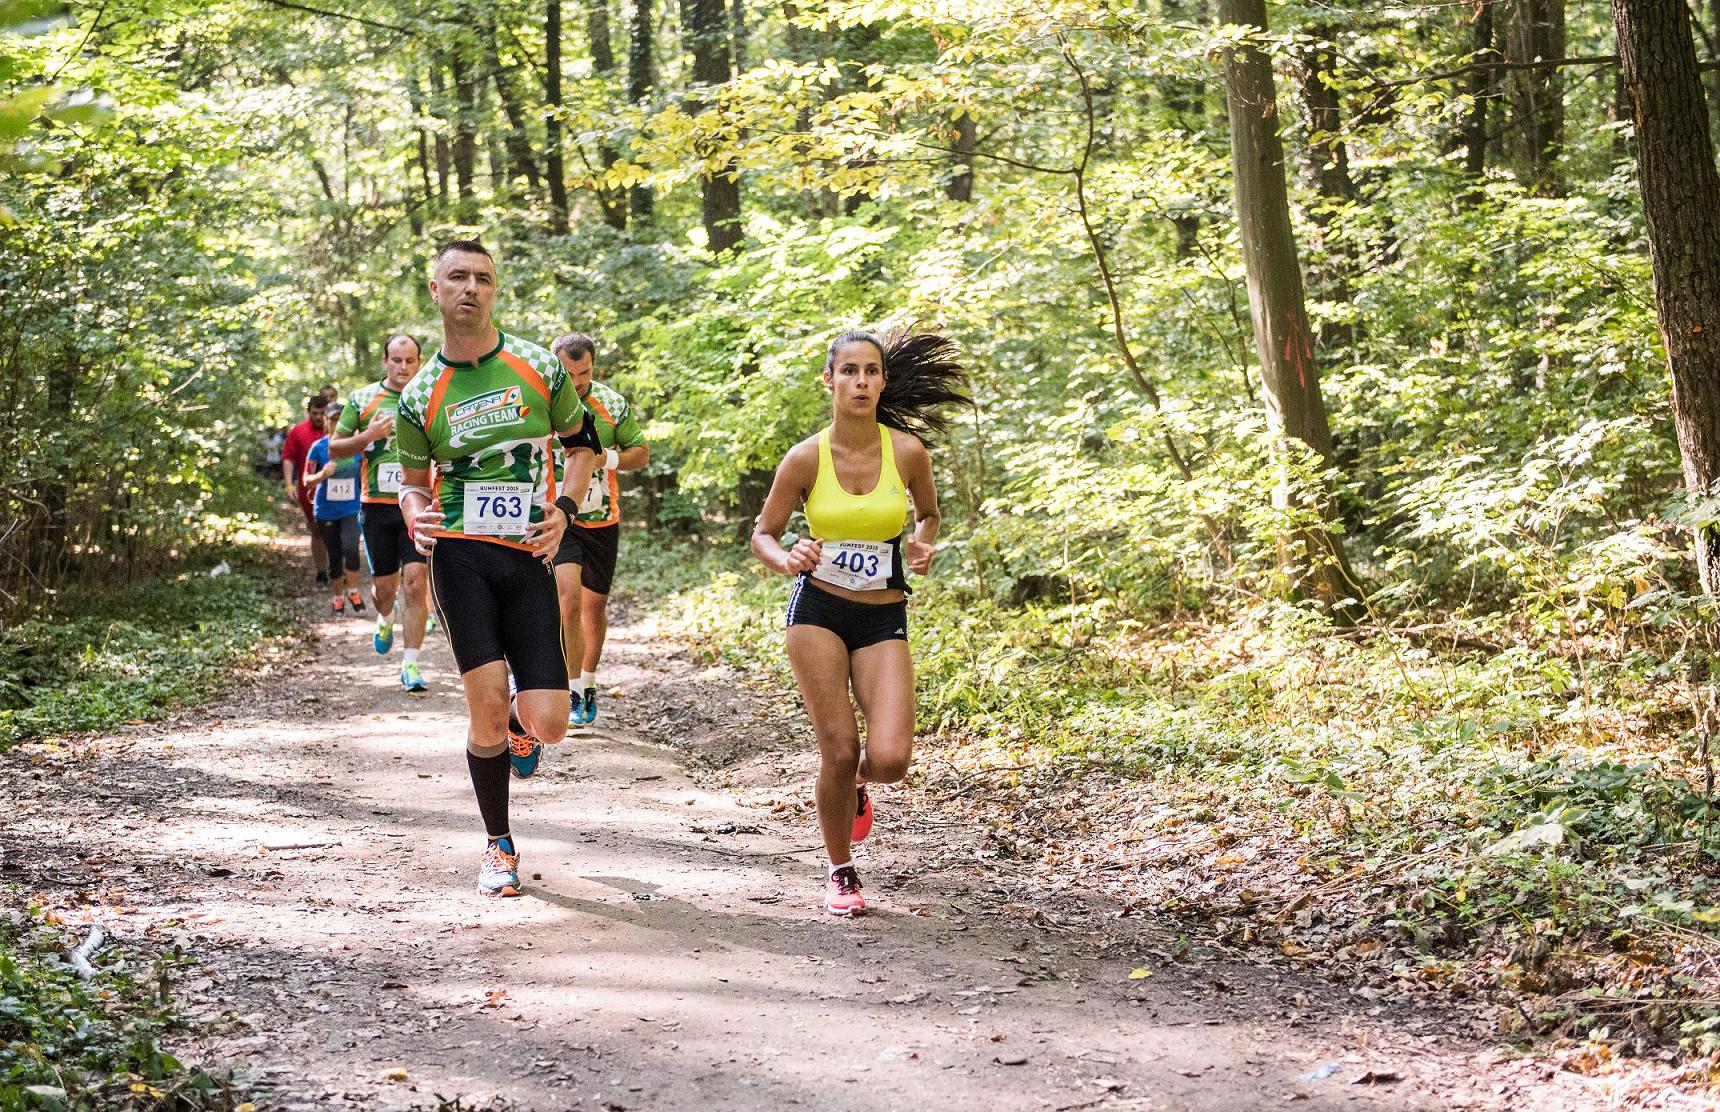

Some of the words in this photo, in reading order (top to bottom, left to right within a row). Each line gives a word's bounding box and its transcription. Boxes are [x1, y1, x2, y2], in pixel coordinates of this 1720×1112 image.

[455, 395, 502, 417] CATENA
[450, 414, 488, 436] RACING
[487, 405, 518, 424] TEAM
[386, 470, 403, 484] 76
[332, 483, 350, 494] 412
[476, 496, 522, 518] 763
[831, 550, 879, 577] 403
